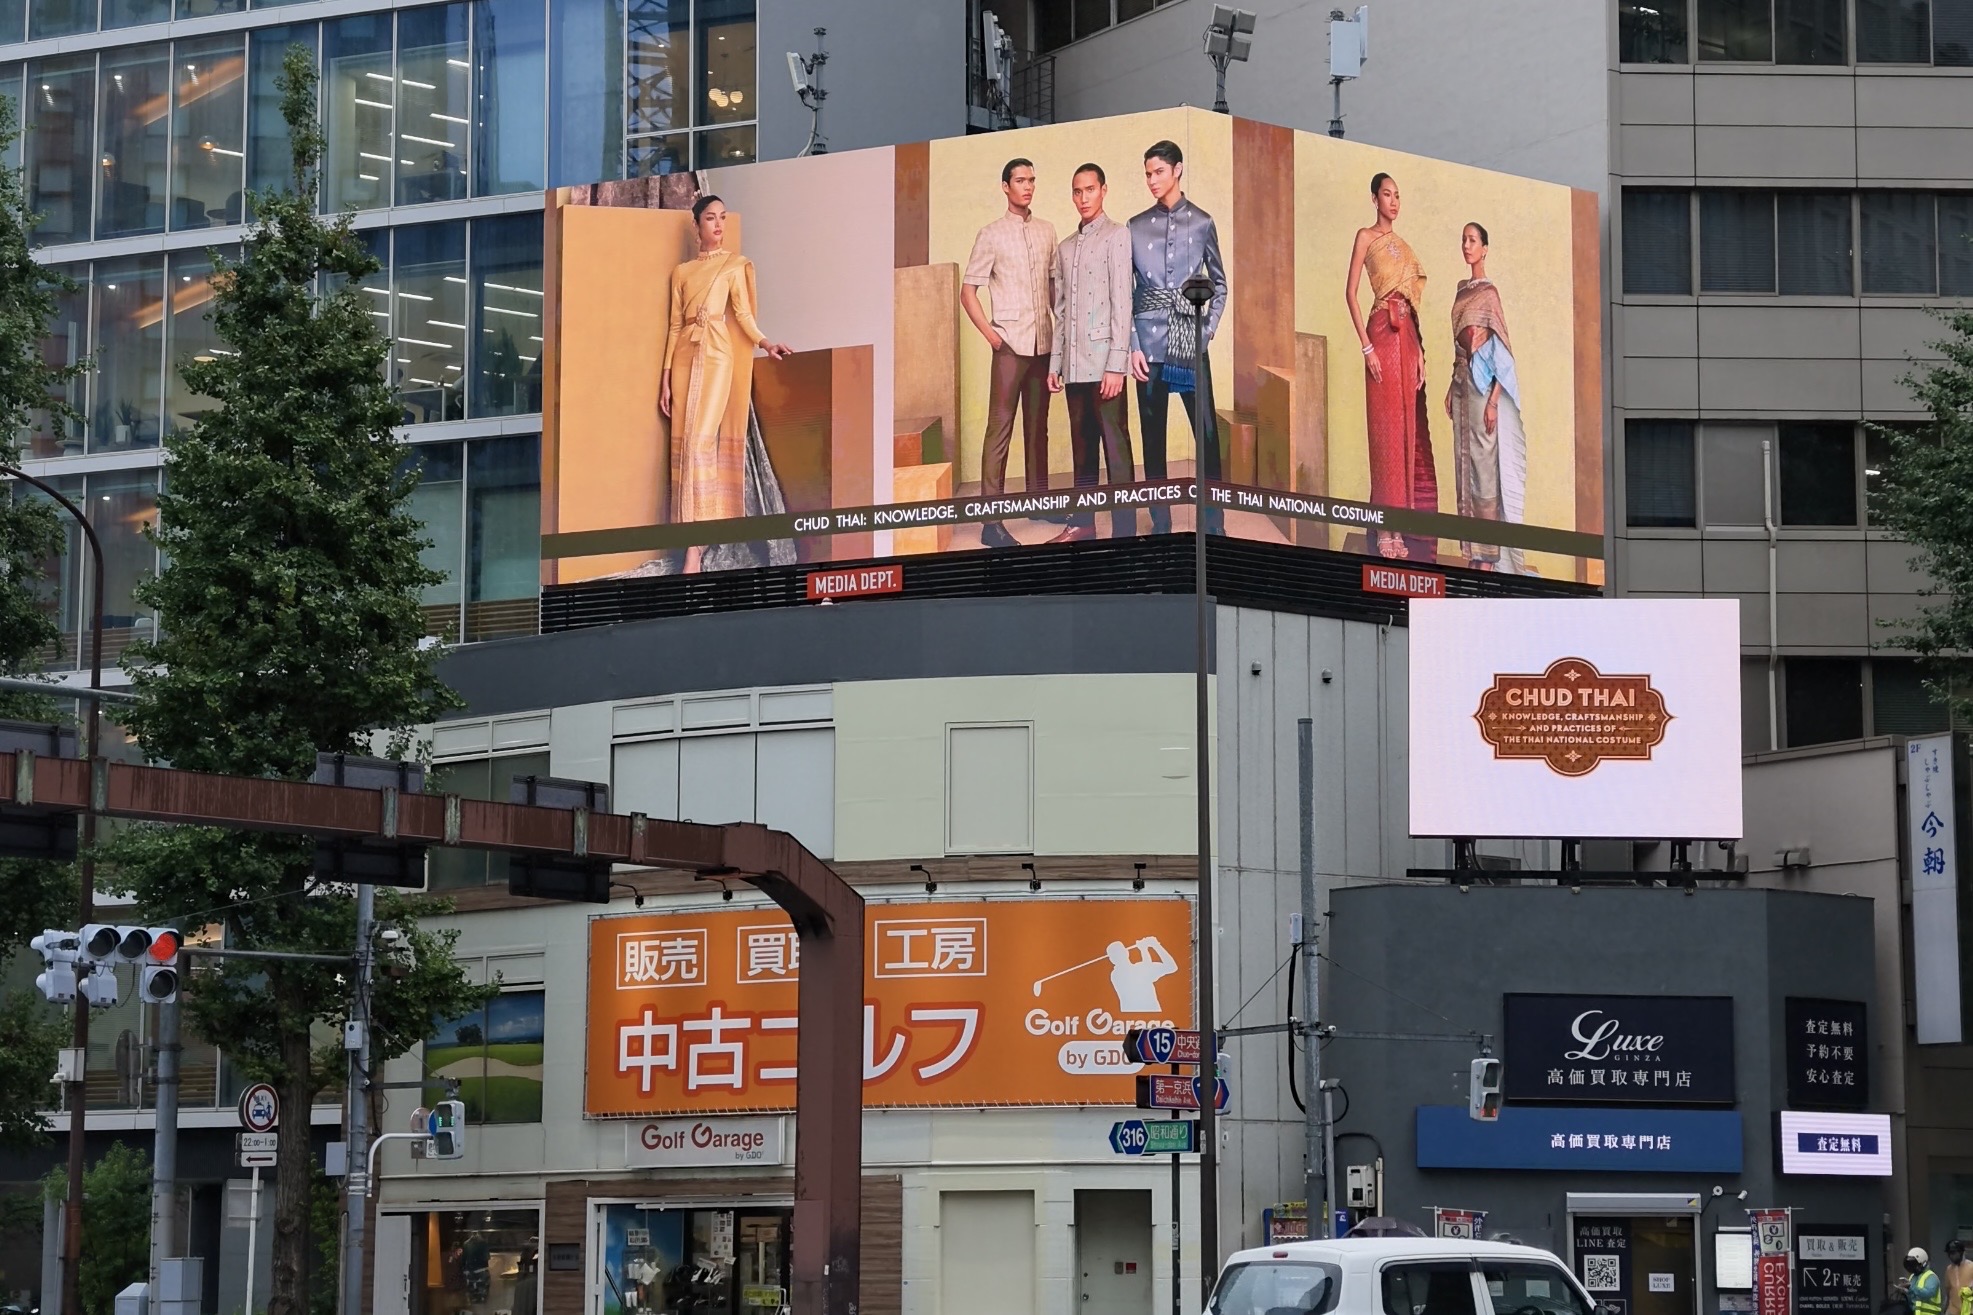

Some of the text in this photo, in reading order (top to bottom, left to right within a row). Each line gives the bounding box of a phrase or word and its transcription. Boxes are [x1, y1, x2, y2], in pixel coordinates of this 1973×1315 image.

[794, 516, 830, 532] CHUD
[836, 513, 867, 528] THAI:
[874, 505, 958, 525] KNOWLEDGE,
[965, 495, 1070, 517] CRAFTSMANSHIP
[1077, 492, 1107, 507] AND
[1114, 485, 1181, 504] PRACTICES
[1211, 487, 1232, 503] THE
[1237, 491, 1263, 508] THAI
[1269, 496, 1326, 516] NATIONAL
[1332, 504, 1384, 525] COSTUME
[815, 570, 897, 594] MEDIA DEPT.
[1370, 569, 1441, 595] MEDIA DEPT.
[1505, 688, 1635, 707] CHUD THAI
[1502, 712, 1644, 722] KNOWLEDGE, CRAFTSMANSHIP
[1529, 724, 1617, 733] AND PRACTICES OF
[1503, 735, 1641, 744] THE THAI NATIONAL COSTUME
[1910, 744, 1921, 753] 2F
[1921, 811, 1946, 876] 今朝
[748, 933, 799, 976] 買
[885, 927, 976, 970] 工房
[624, 938, 699, 982] 販売
[1025, 1008, 1080, 1036] Golf
[1805, 1018, 1854, 1037] 査定無料
[1153, 1032, 1171, 1054] 15
[1564, 1010, 1664, 1061] Luxe
[1066, 1050, 1088, 1068] by
[1614, 1054, 1661, 1062] GINZA
[1806, 1043, 1854, 1061] 予約不要
[1547, 1068, 1692, 1088] 高価買取専門店
[1806, 1068, 1855, 1086] 安心査定
[1155, 1079, 1191, 1096] 第一京浜
[641, 1123, 764, 1151] Golf Garage
[1122, 1127, 1145, 1147] 316
[1150, 1124, 1188, 1140] 昭和通り
[1551, 1132, 1671, 1150] 高価買取専門店
[1817, 1136, 1861, 1153] 査定無料
[735, 1152, 744, 1161] by
[1576, 1238, 1626, 1248] LINE 査定
[1806, 1238, 1825, 1251] 買取
[1838, 1238, 1857, 1251] 販売
[1823, 1267, 1861, 1287] 2F 販売
